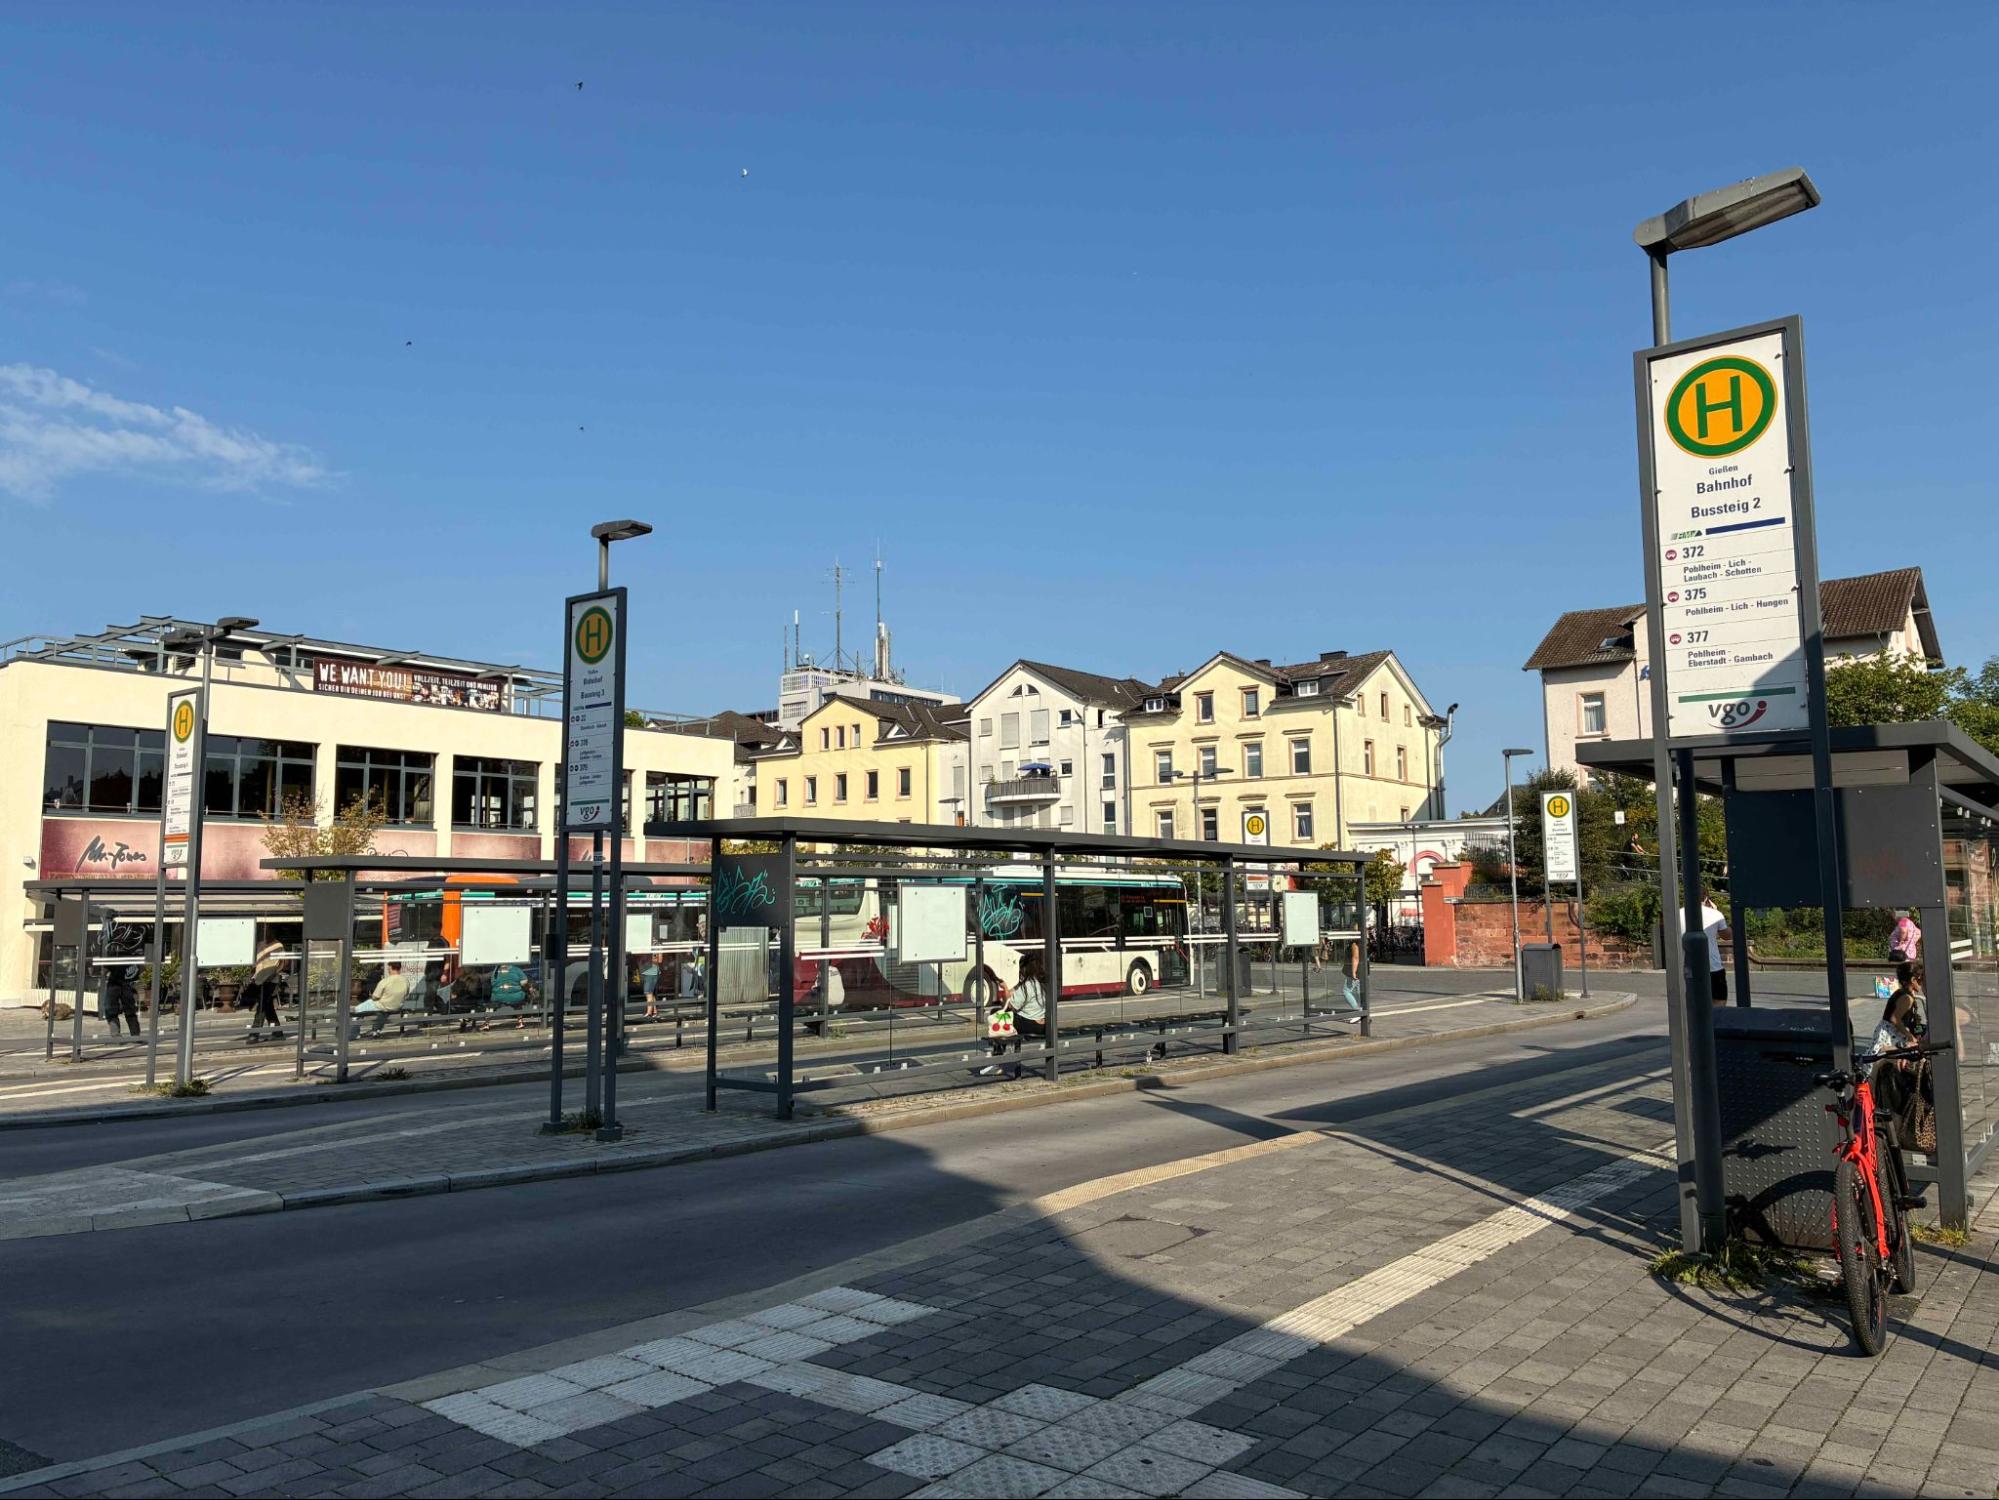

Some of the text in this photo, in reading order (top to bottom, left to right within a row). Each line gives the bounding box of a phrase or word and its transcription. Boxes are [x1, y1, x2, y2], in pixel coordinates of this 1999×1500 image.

[1696, 375, 1743, 439] H
[1708, 465, 1739, 475] Gießen
[1696, 474, 1753, 494] Bahnhof
[1691, 497, 1761, 518] Bussteig 2
[1682, 545, 1705, 559] 372
[1683, 563, 1721, 574] Pohlheim
[1728, 559, 1746, 568] Lich
[1684, 571, 1718, 582] Laubach
[1725, 566, 1762, 577] Schotten
[1684, 588, 1706, 601] 375
[1685, 605, 1724, 617] Pohlheim
[1731, 602, 1749, 611] Lich
[1756, 598, 1789, 609] Hungen
[585, 618, 602, 653] H
[1687, 630, 1709, 644] 377
[1688, 649, 1726, 659] Pohlheim
[1688, 657, 1726, 668] Eberstadt
[1733, 652, 1773, 663] Gambach
[319, 663, 408, 690] WE WANT YOU!
[178, 708, 189, 735] H
[1553, 799, 1563, 814] H
